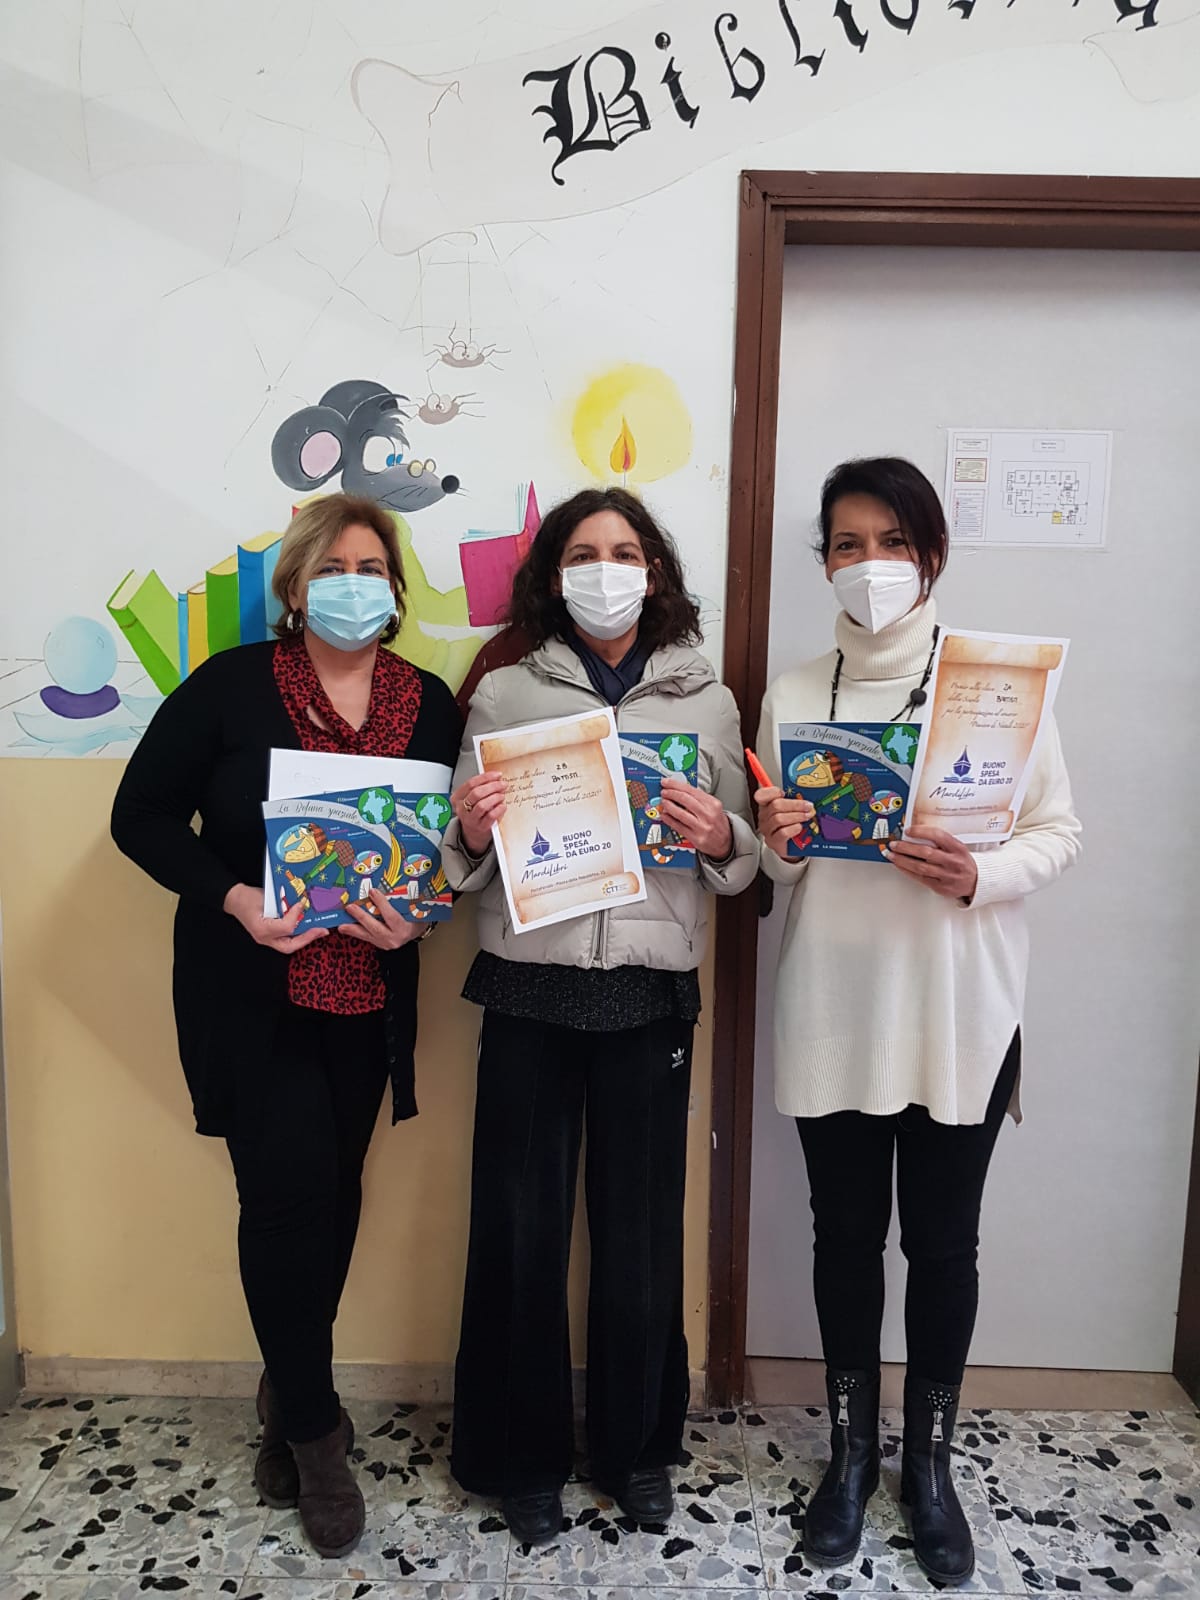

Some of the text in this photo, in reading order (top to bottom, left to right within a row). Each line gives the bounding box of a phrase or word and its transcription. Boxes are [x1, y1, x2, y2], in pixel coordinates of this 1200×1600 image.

[982, 761, 1006, 769] BUONO
[980, 770, 1000, 778] SPESA
[978, 778, 988, 786] DA
[988, 777, 1005, 786] EURO
[562, 829, 592, 842] BUONO
[563, 839, 589, 851] SPESA
[565, 841, 612, 858] DA EURO 20
